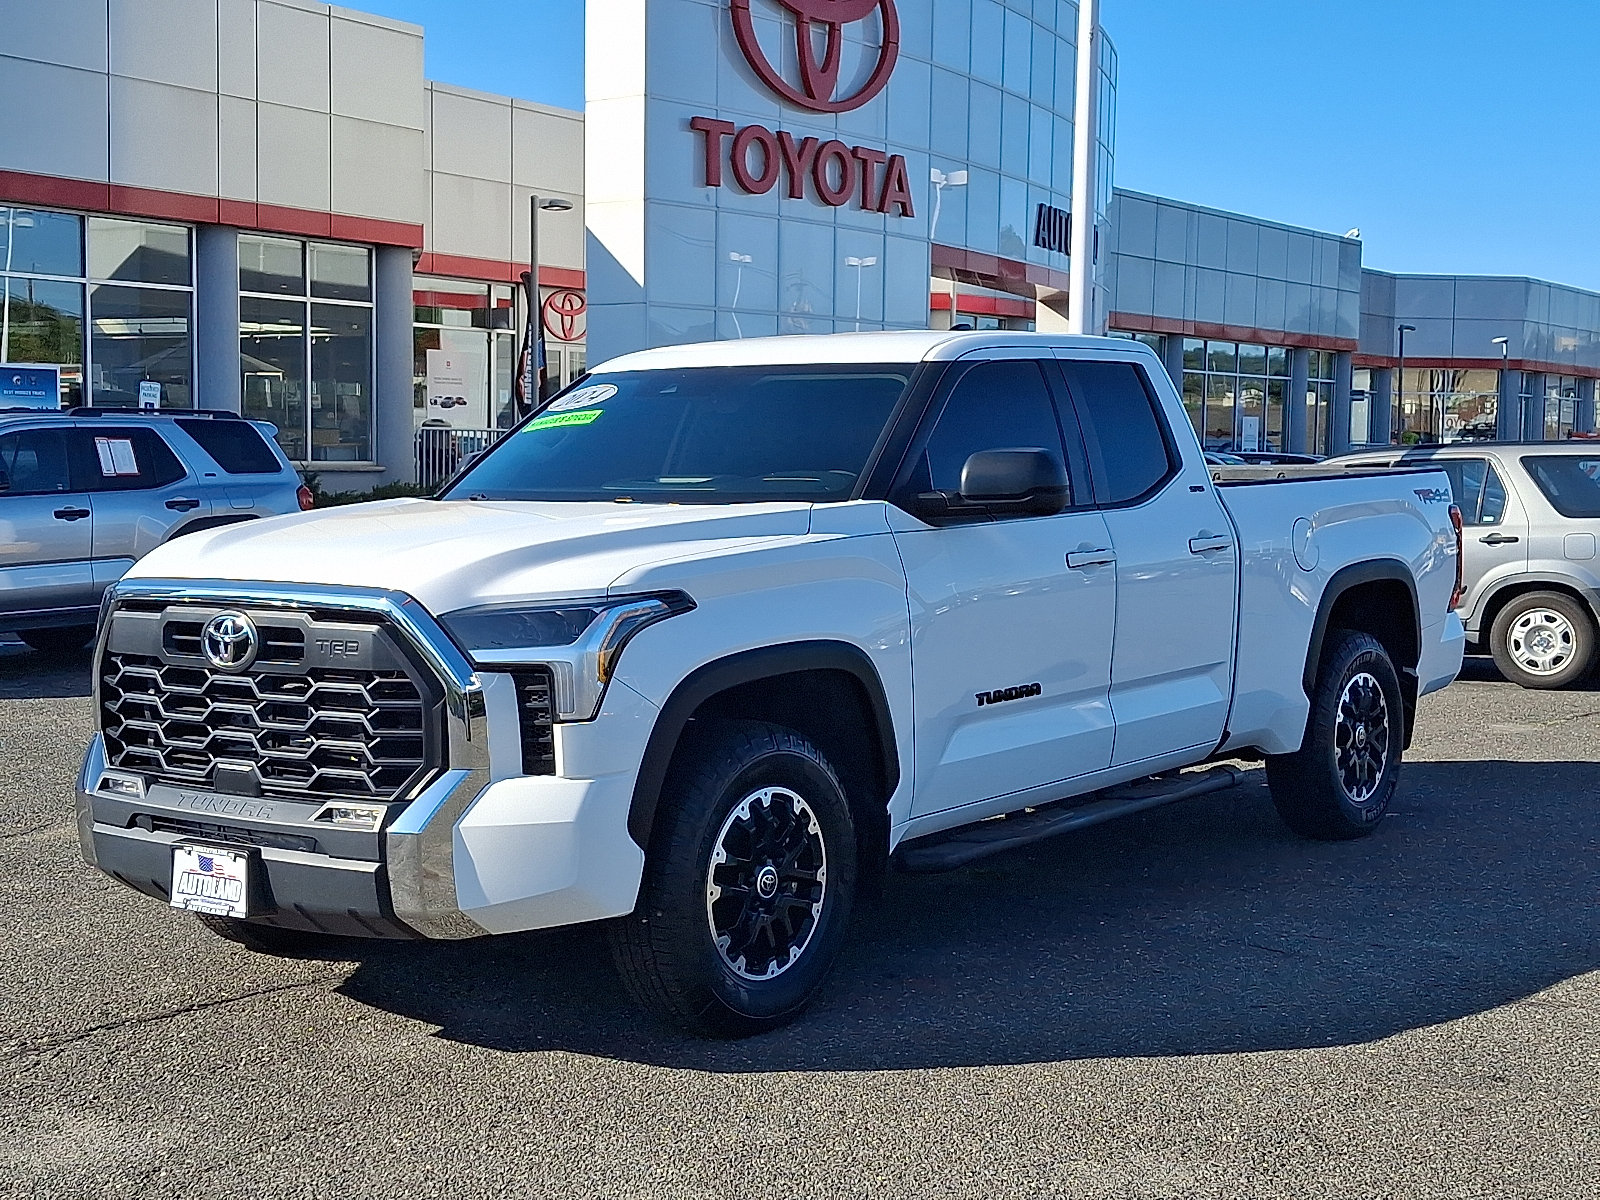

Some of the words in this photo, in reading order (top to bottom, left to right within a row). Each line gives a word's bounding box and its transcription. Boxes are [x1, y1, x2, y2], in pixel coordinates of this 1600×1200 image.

[690, 116, 915, 218] TOYOTA
[315, 639, 360, 659] TRD
[975, 682, 1042, 707] TUNDRA
[178, 792, 277, 819] TUNDRA
[176, 870, 243, 903] AUTOLAND
